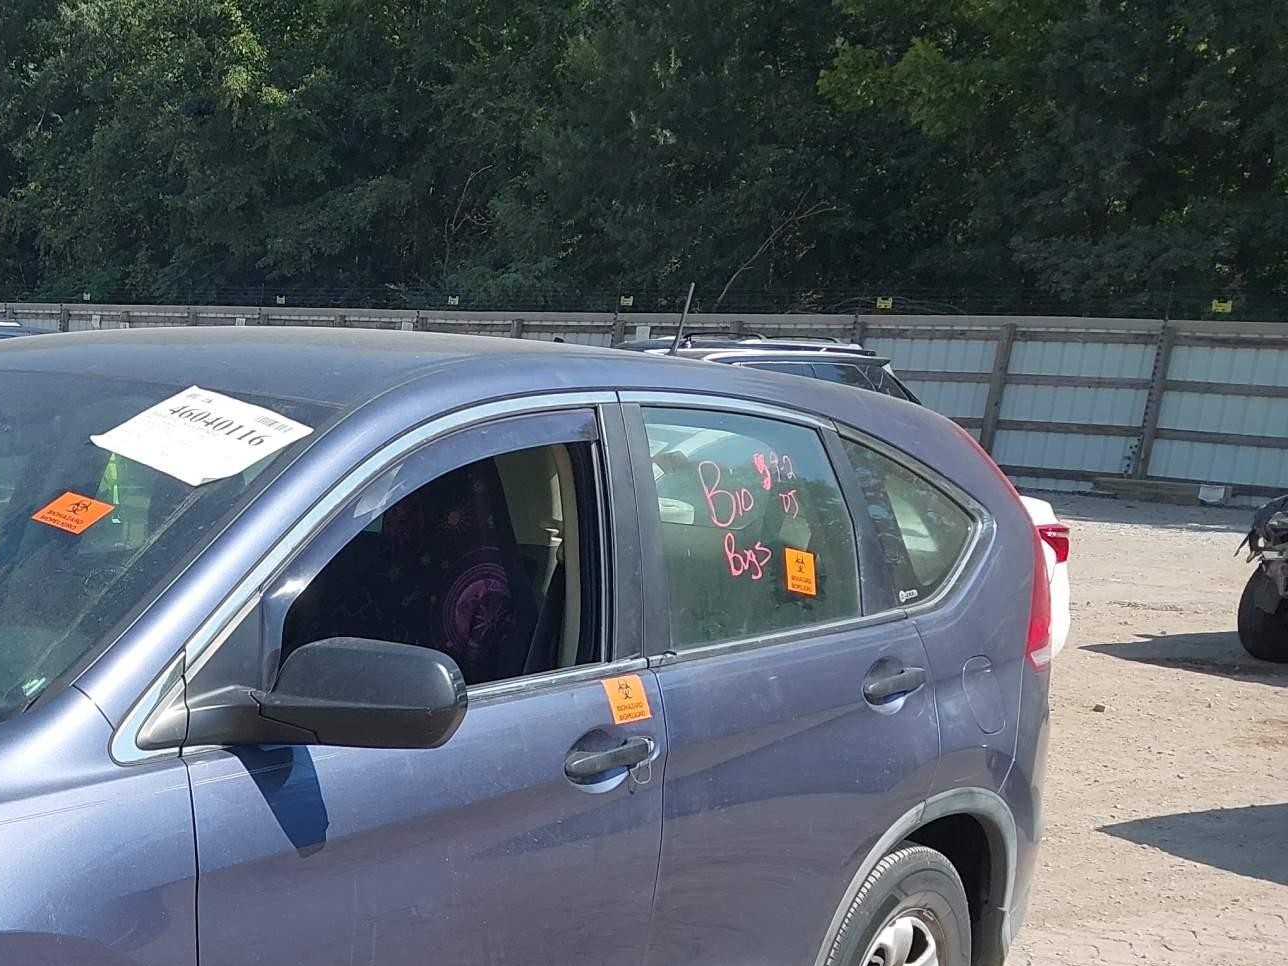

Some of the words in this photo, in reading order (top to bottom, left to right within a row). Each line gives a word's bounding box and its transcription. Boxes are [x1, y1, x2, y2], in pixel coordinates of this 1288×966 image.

[169, 405, 272, 446] 46040116
[46, 510, 83, 525] BIOHAZARD
[616, 701, 643, 711] BIOHAZARD
